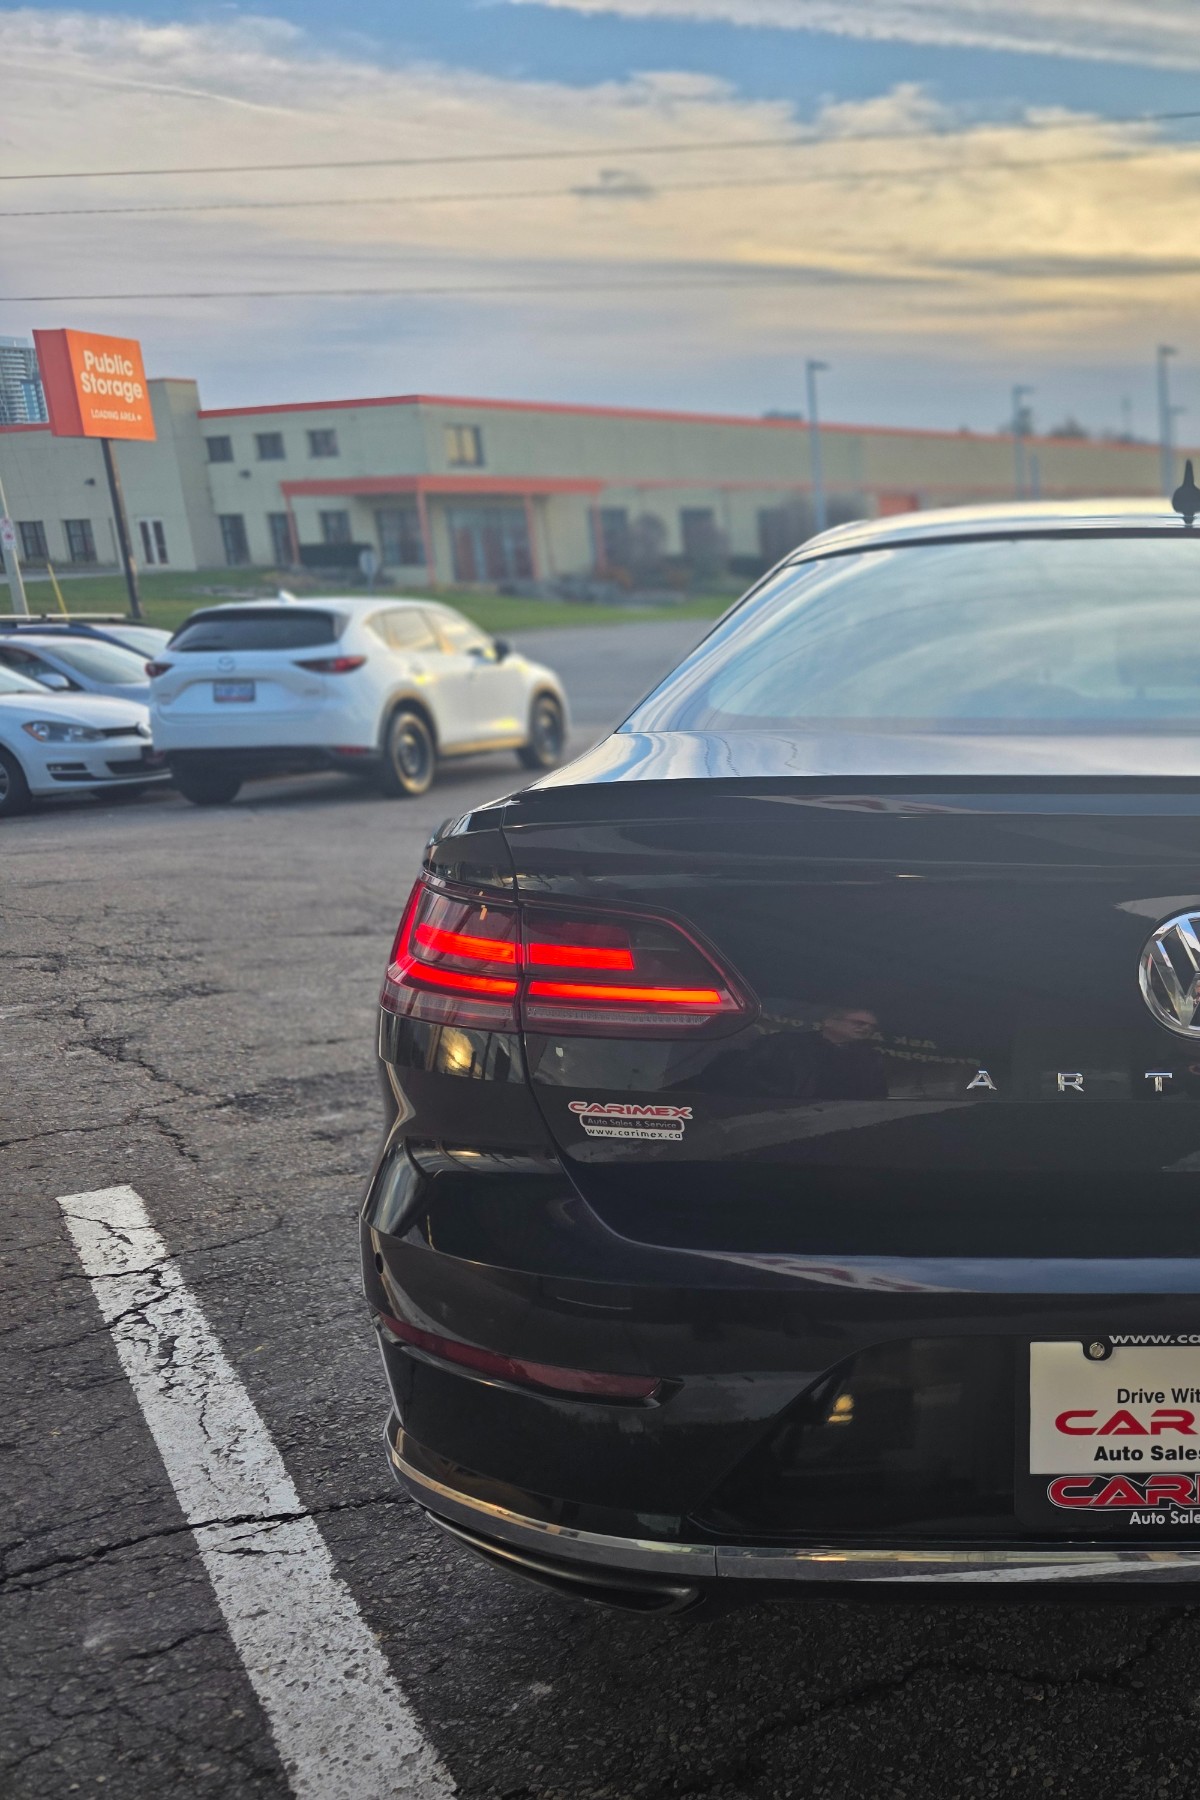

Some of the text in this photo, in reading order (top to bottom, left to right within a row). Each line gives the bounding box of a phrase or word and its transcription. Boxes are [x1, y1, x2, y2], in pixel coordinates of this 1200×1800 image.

[83, 349, 134, 377] Public
[80, 371, 143, 404] Storage
[91, 408, 137, 422] LOADING AREA
[568, 1102, 692, 1118] CARIMEX
[610, 1119, 632, 1127] Sales
[645, 1121, 677, 1129] Service
[587, 1128, 681, 1139] www.carimex.ca
[1117, 1388, 1165, 1404] Drive
[1093, 1446, 1144, 1461] Auto
[1129, 1511, 1166, 1525] Auto
